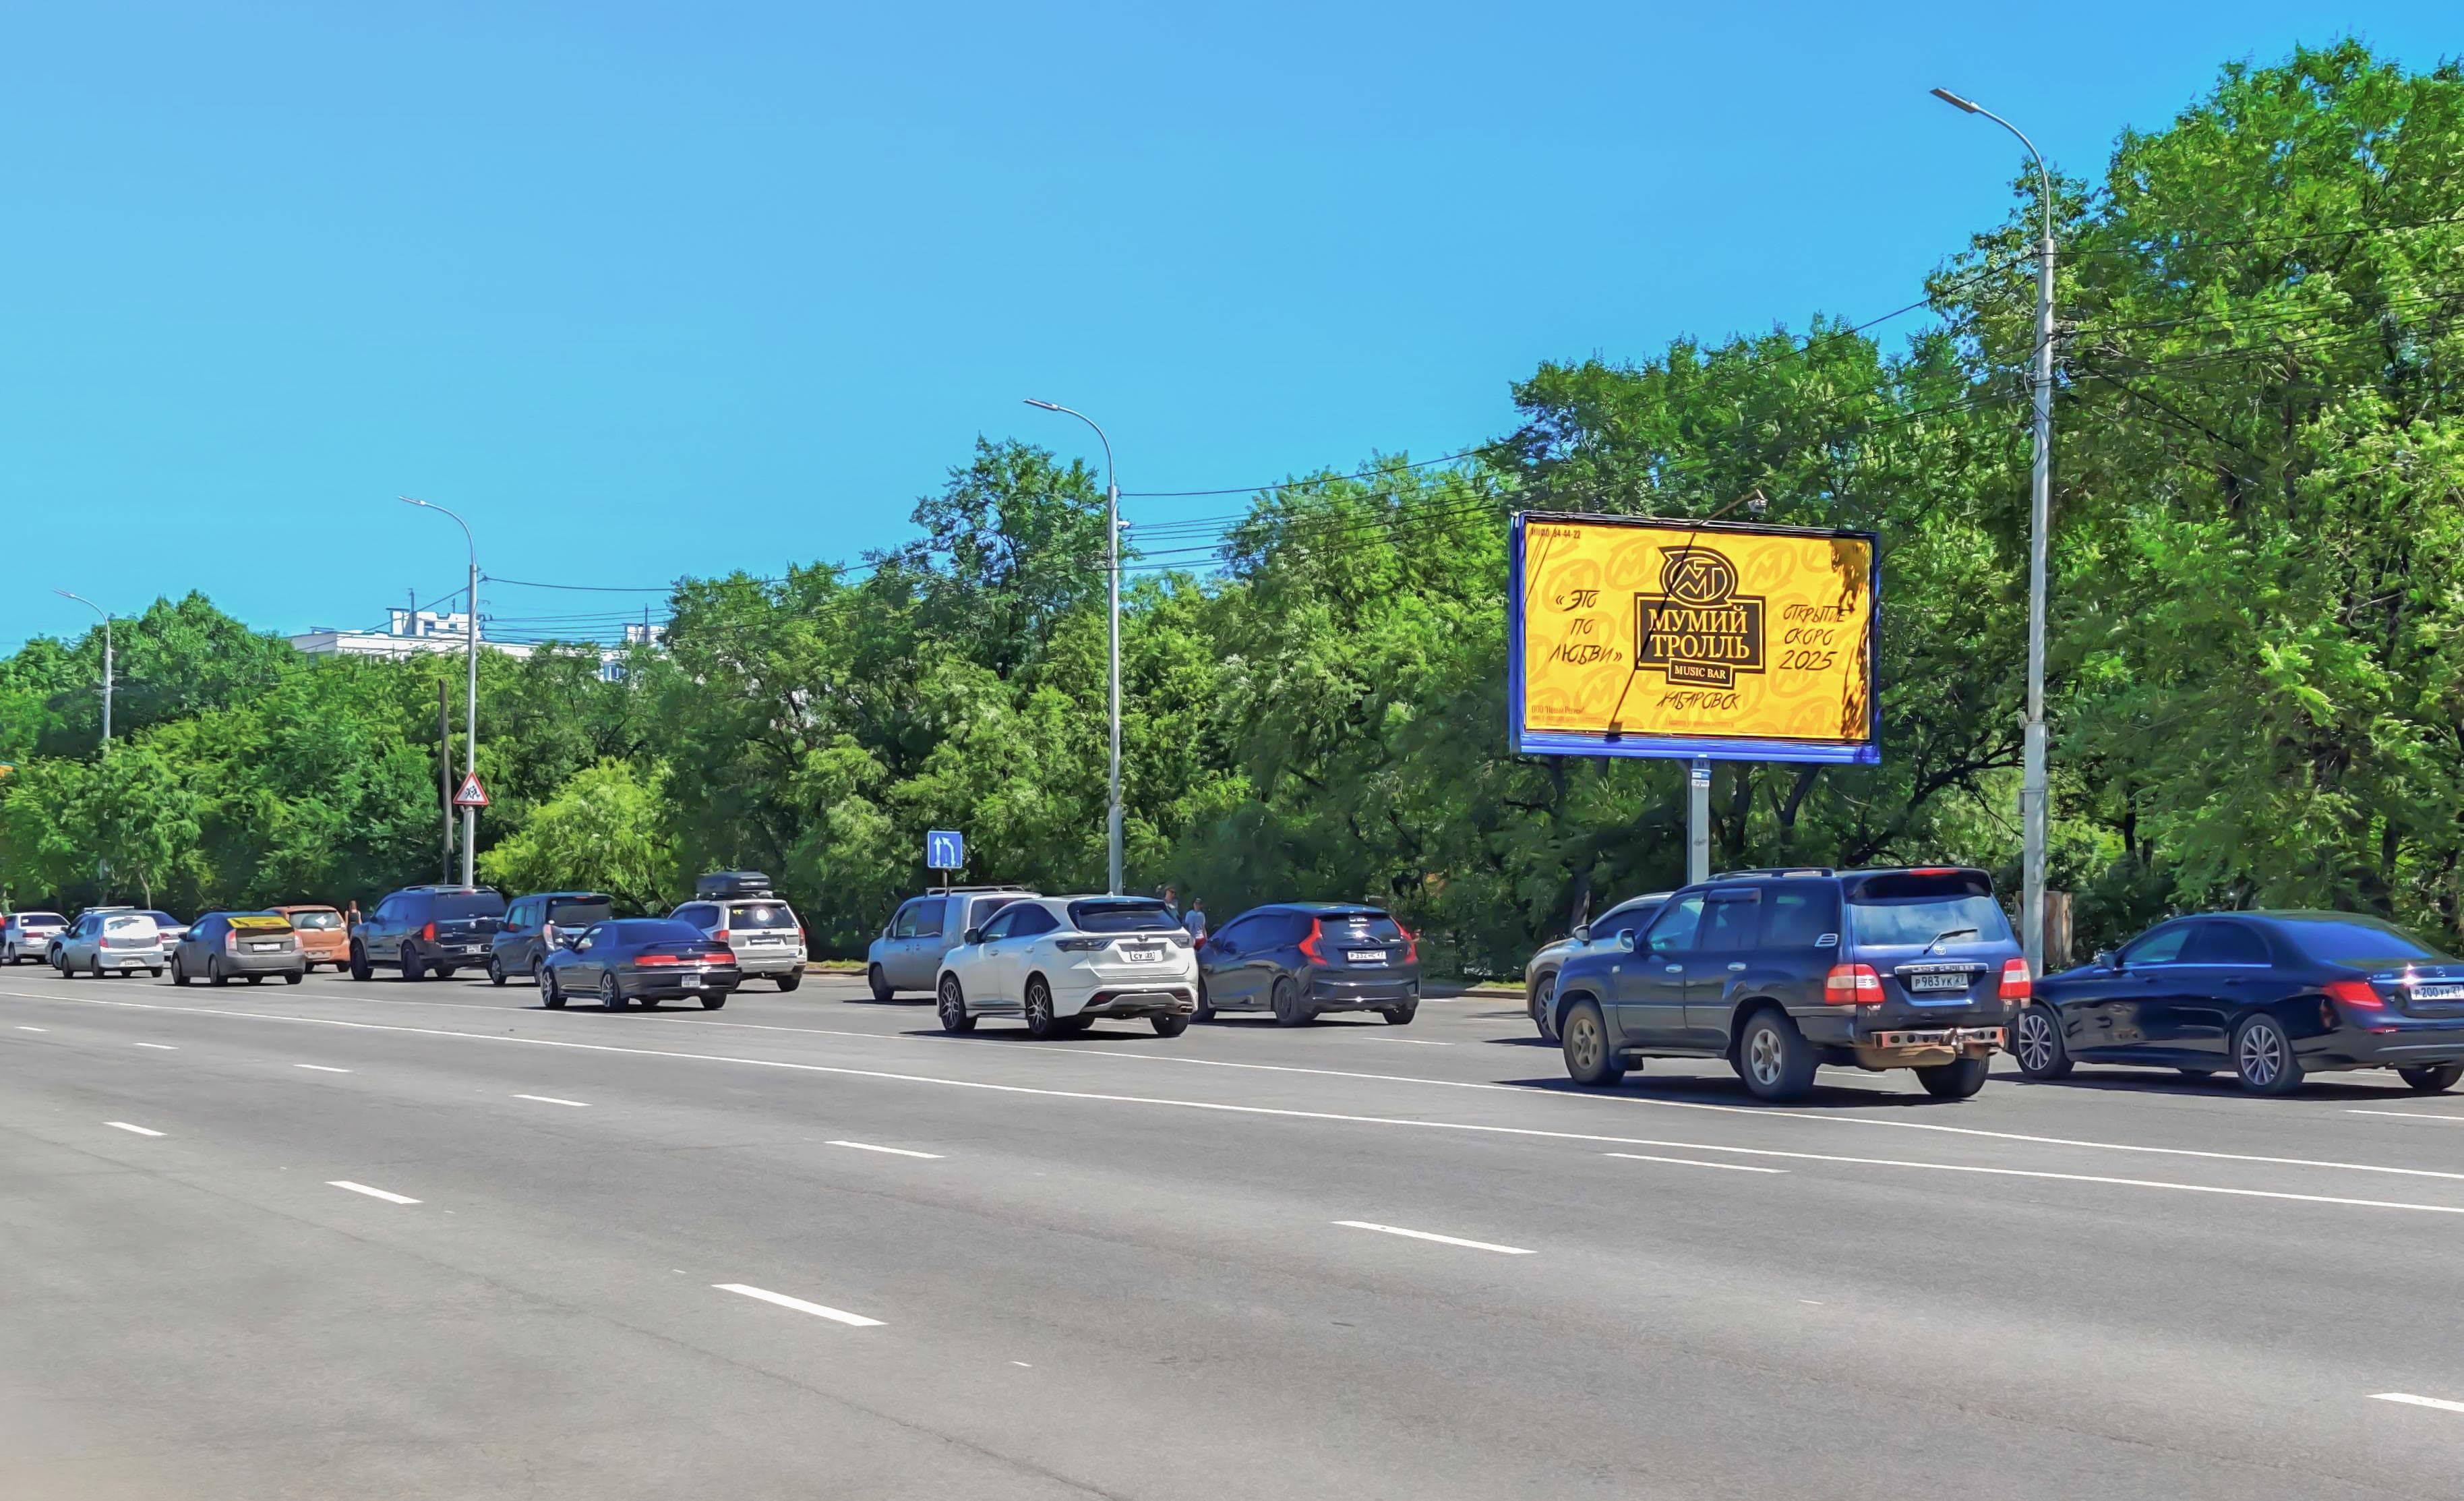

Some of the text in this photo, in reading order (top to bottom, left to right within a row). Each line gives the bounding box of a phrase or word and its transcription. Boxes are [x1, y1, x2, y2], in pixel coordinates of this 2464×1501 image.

[1570, 618, 1596, 635] ПО
[1648, 605, 1748, 634] МУМИЙ
[1650, 634, 1751, 659] ТРОЛЛЬ
[1784, 628, 1836, 645] СКОРО
[1778, 649, 1838, 671] 2025
[1675, 665, 1726, 680] MUSIC BAR
[1656, 690, 1741, 710] ХАБАРОВСК
